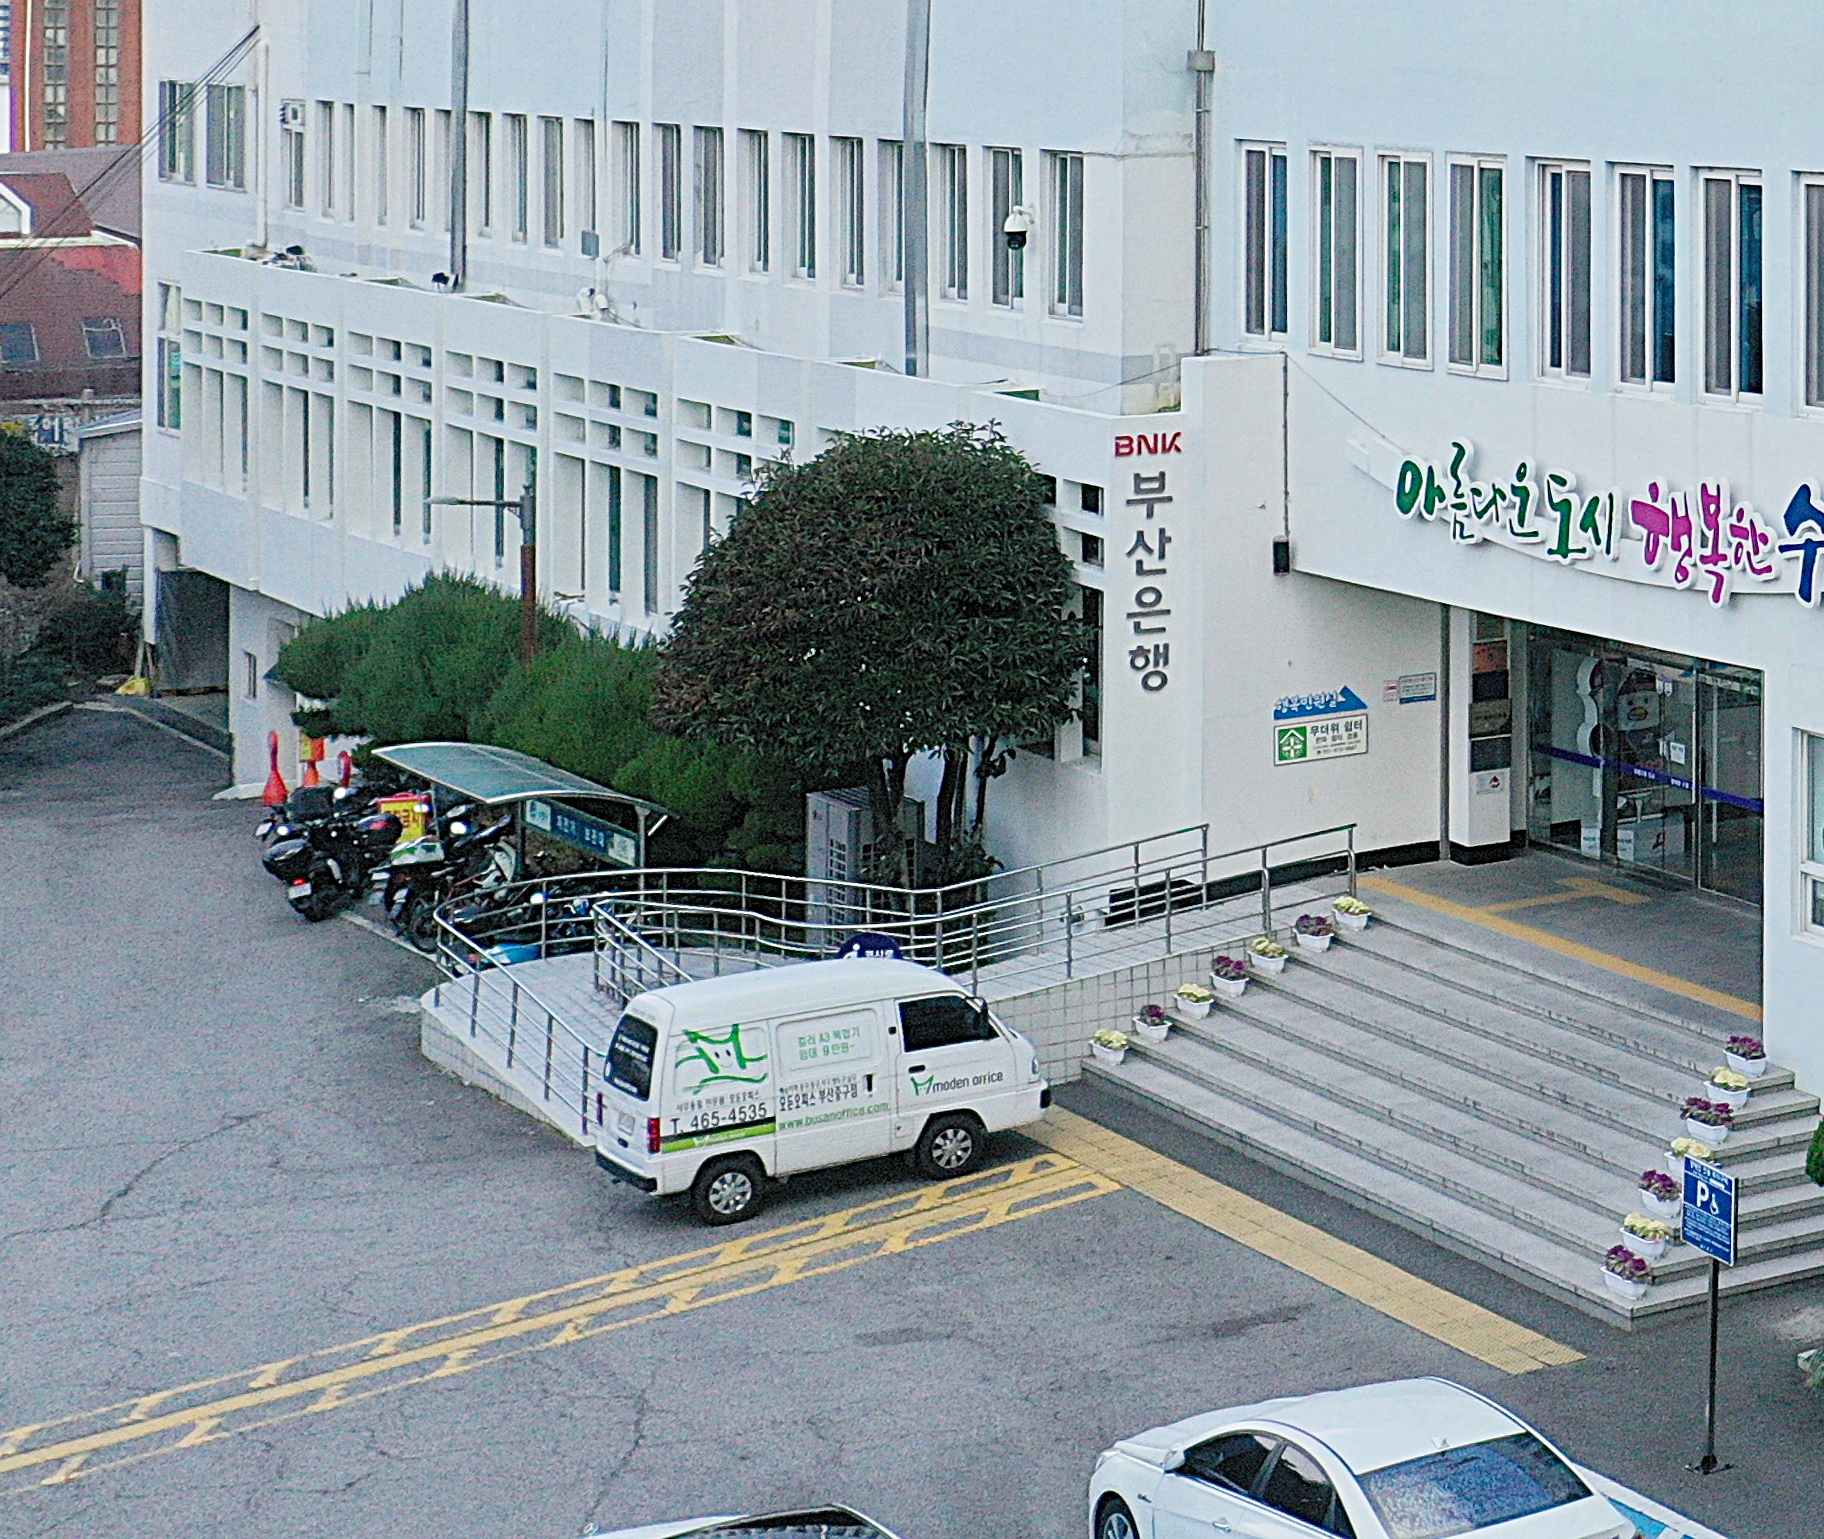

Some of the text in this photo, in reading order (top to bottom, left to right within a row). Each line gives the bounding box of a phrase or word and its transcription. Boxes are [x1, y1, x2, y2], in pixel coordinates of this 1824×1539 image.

[1114, 432, 1182, 456] BNK
[1395, 438, 1539, 544] 아름다운
[1545, 471, 1617, 561] 도시
[1629, 480, 1775, 605] 행복한
[1125, 471, 1173, 692] 부산은행
[1310, 719, 1363, 736] 무더위 쉼터
[973, 1071, 1004, 1085] office
[691, 1102, 767, 1130] 465-4535
[1697, 1181, 1709, 1207] P
